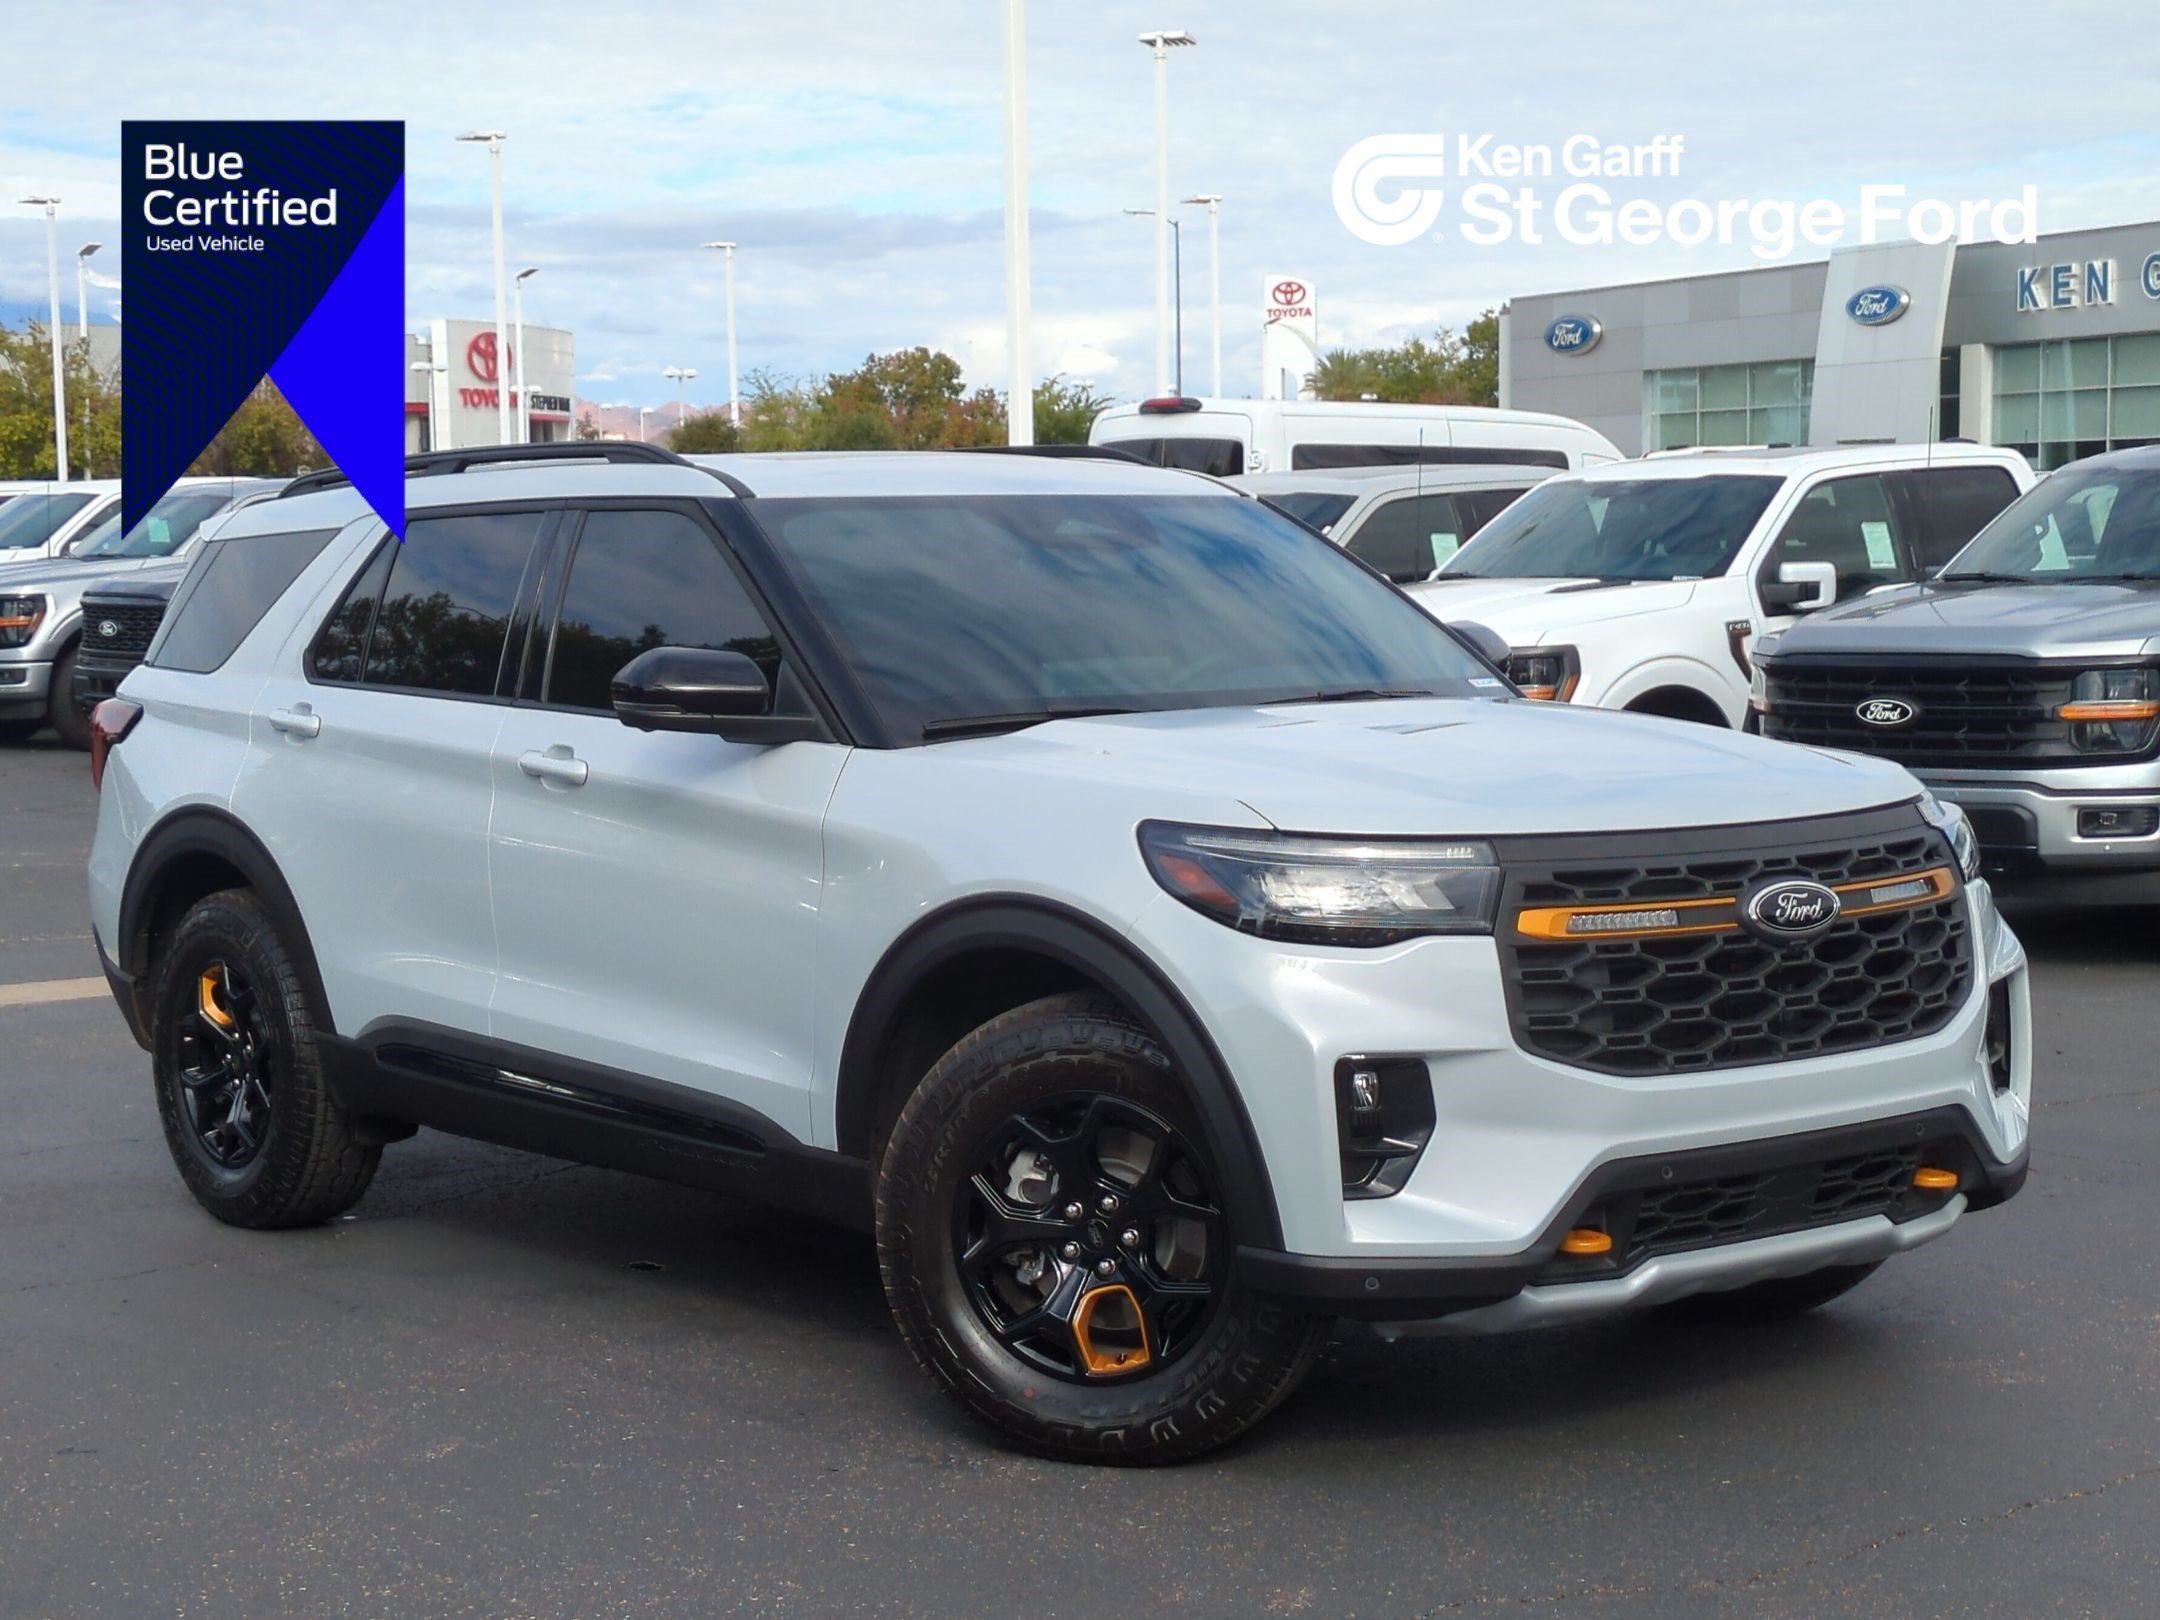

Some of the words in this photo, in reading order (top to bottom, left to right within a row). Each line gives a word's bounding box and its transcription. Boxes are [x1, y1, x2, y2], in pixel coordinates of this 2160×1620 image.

[2017, 259, 2114, 312] KEN
[1266, 307, 1312, 318] TOYOTA
[1854, 292, 1888, 316] Ford
[1551, 322, 1582, 347] Ford
[1866, 702, 1901, 720] Ford
[1775, 892, 1823, 921] Ford
